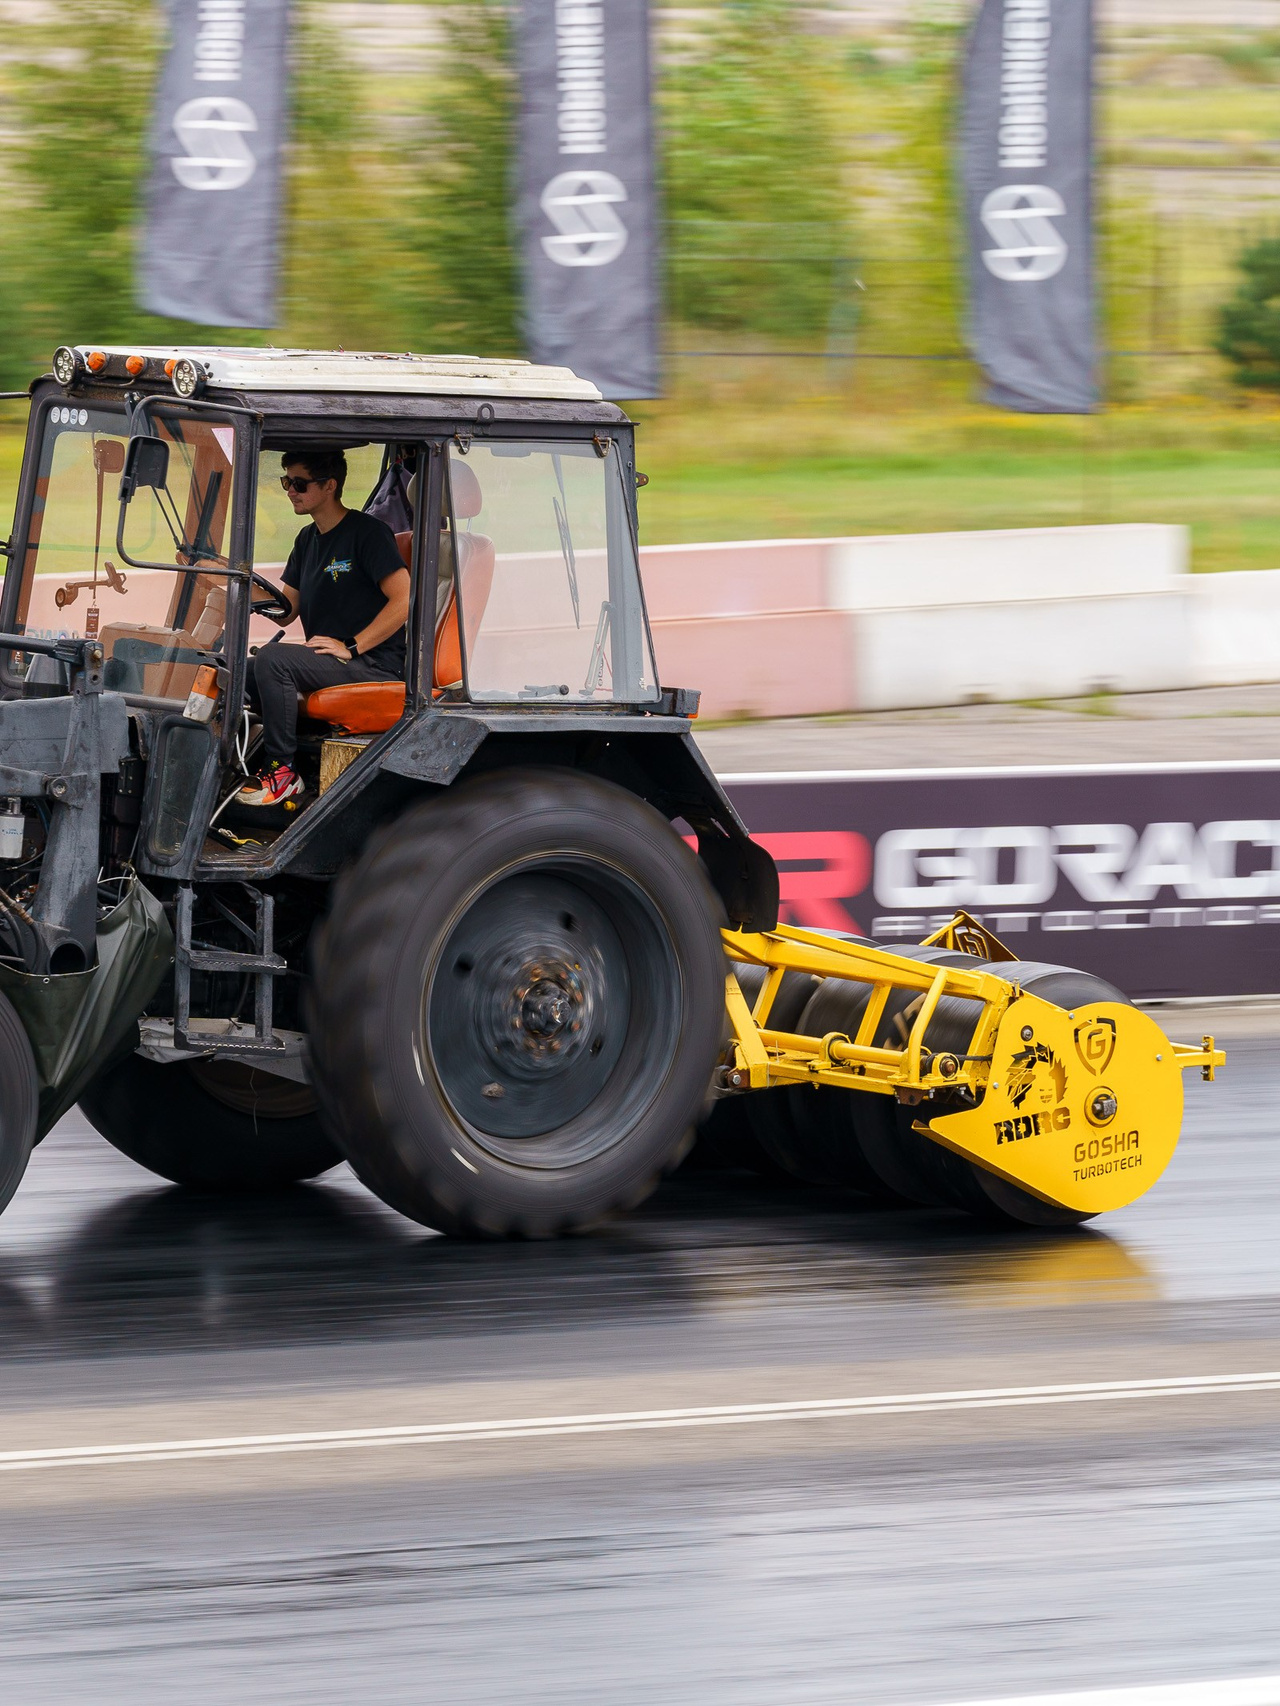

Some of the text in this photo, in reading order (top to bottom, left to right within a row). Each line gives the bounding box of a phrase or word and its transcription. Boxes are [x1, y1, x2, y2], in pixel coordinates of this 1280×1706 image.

[993, 1106, 1071, 1145] RDRC
[1074, 1130, 1140, 1163] GOSHA
[1073, 1154, 1143, 1182] TURBOTECH
